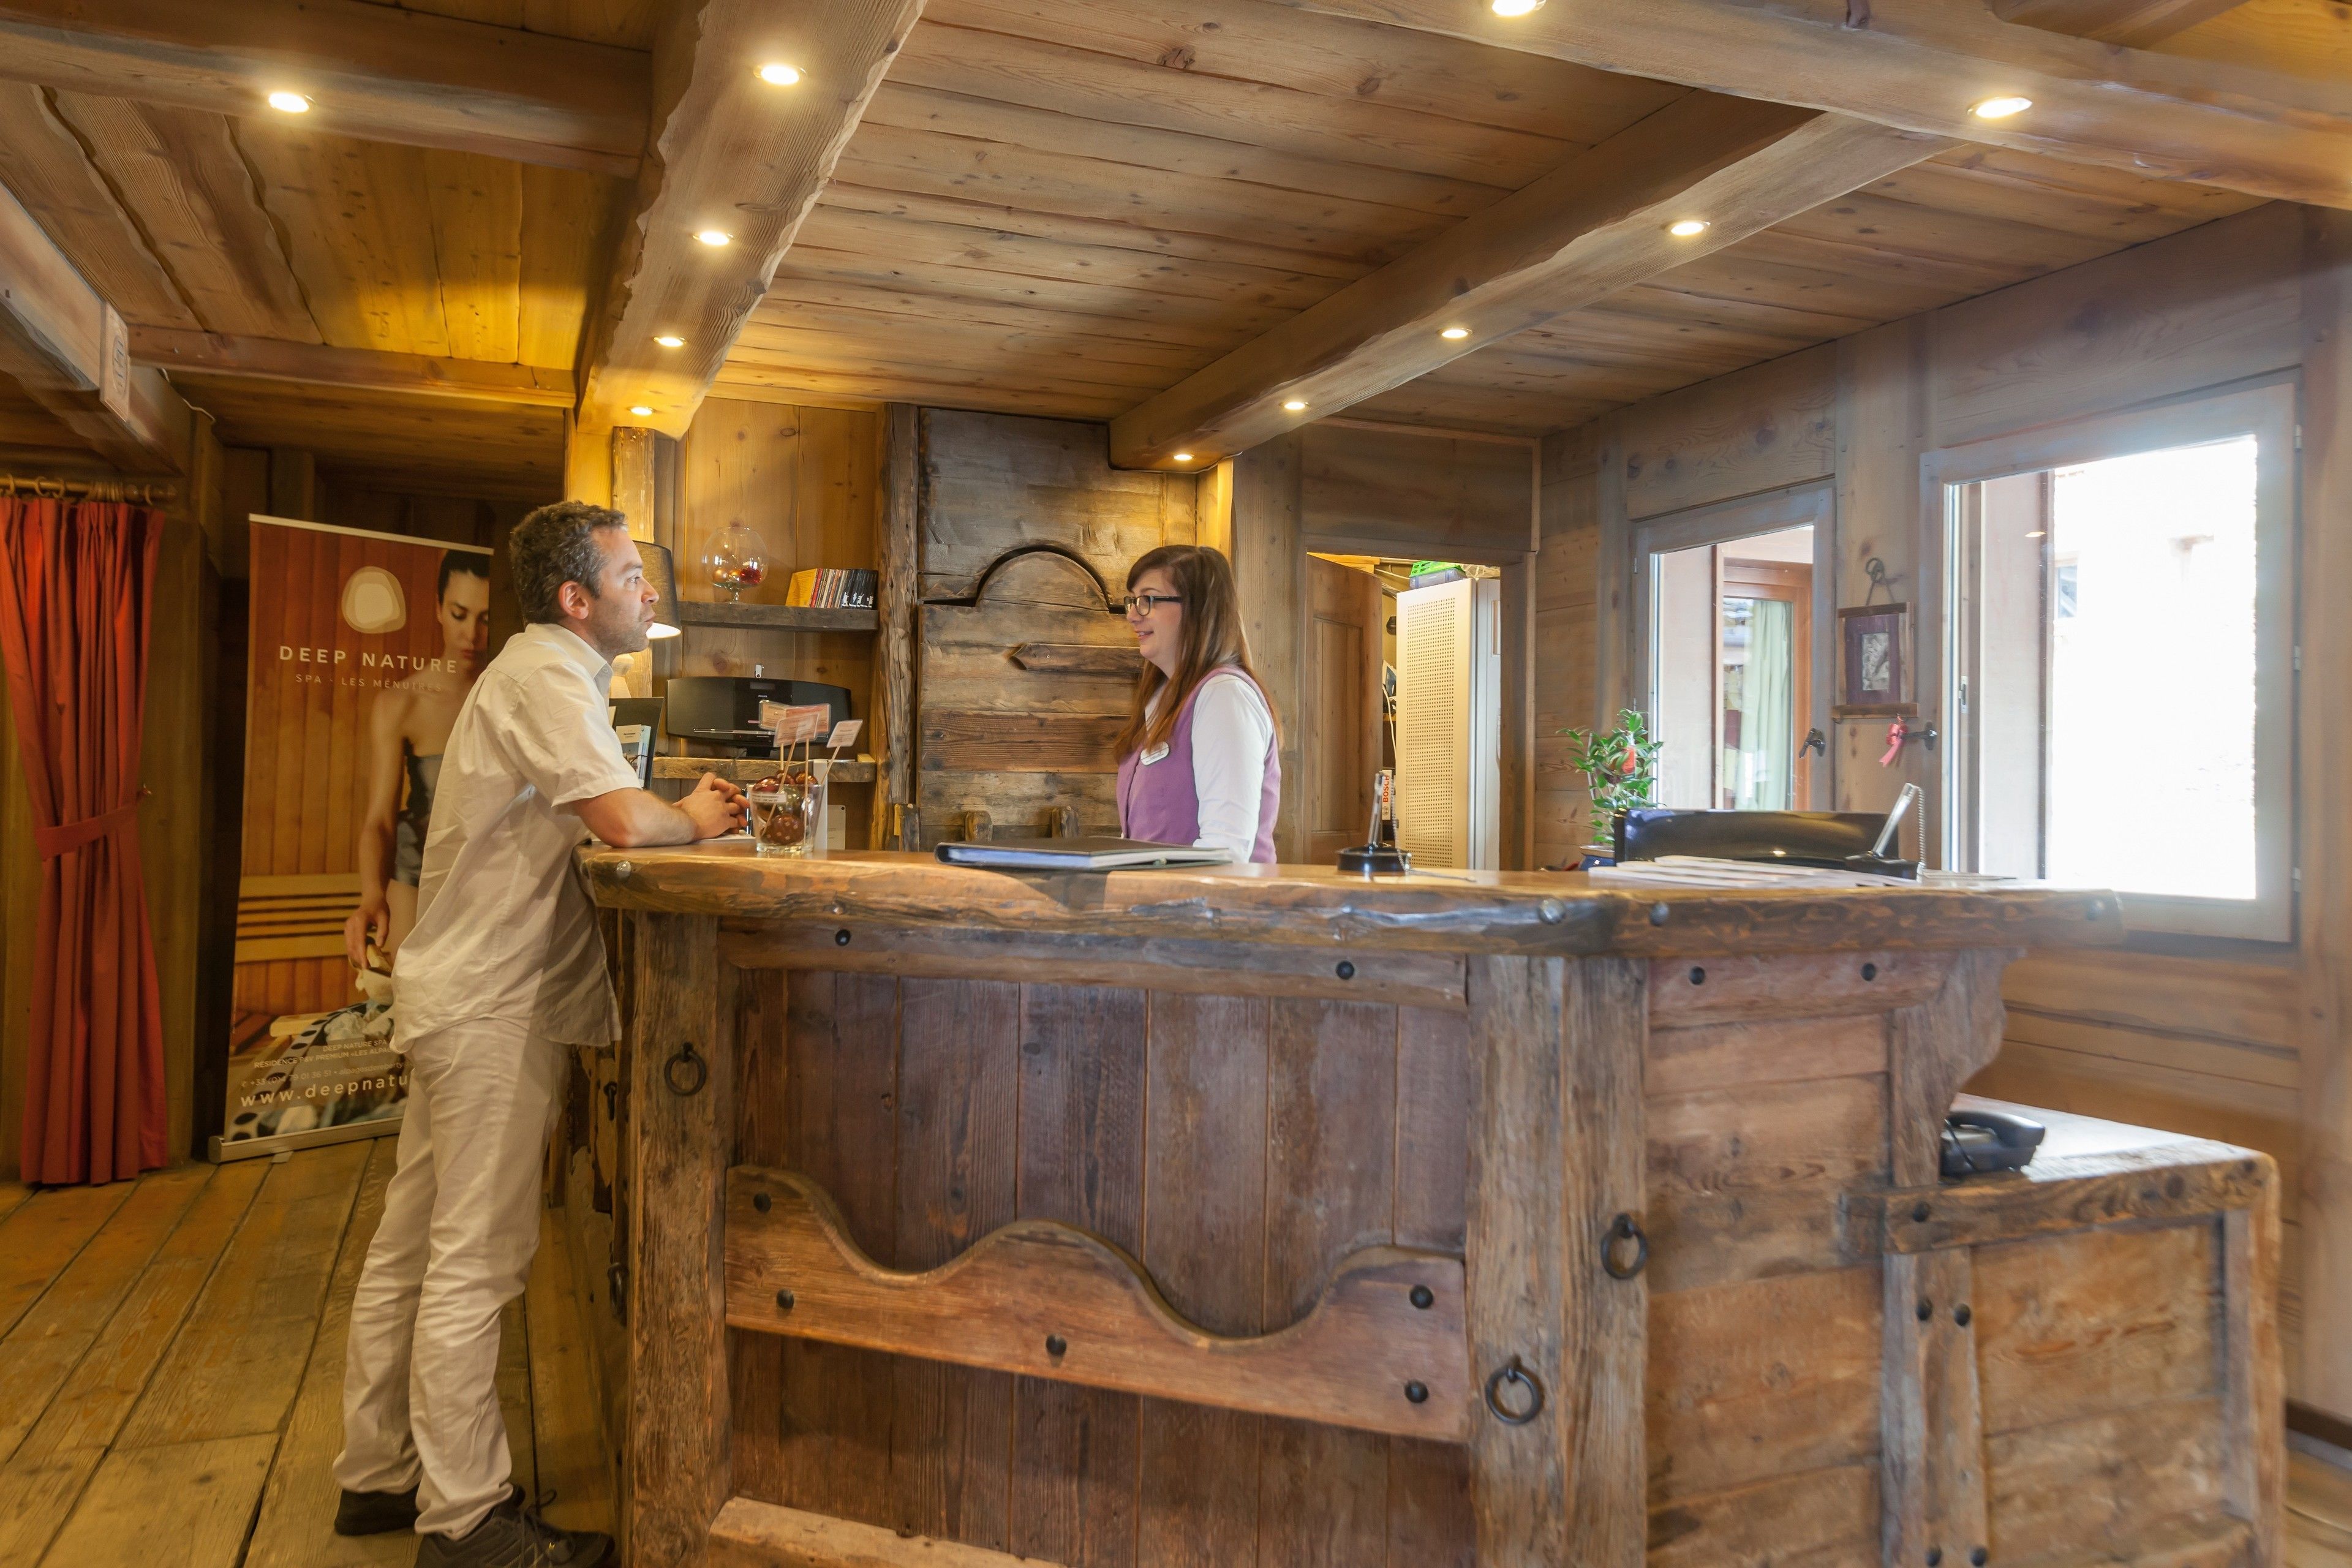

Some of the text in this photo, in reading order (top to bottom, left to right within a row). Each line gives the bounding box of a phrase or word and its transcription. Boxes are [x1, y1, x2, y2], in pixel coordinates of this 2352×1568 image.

[279, 645, 457, 673] DEEP NATURE
[295, 674, 322, 684] SPA
[341, 677, 365, 687] LES
[323, 1044, 342, 1052] DEEP
[344, 1041, 372, 1049] NATURE
